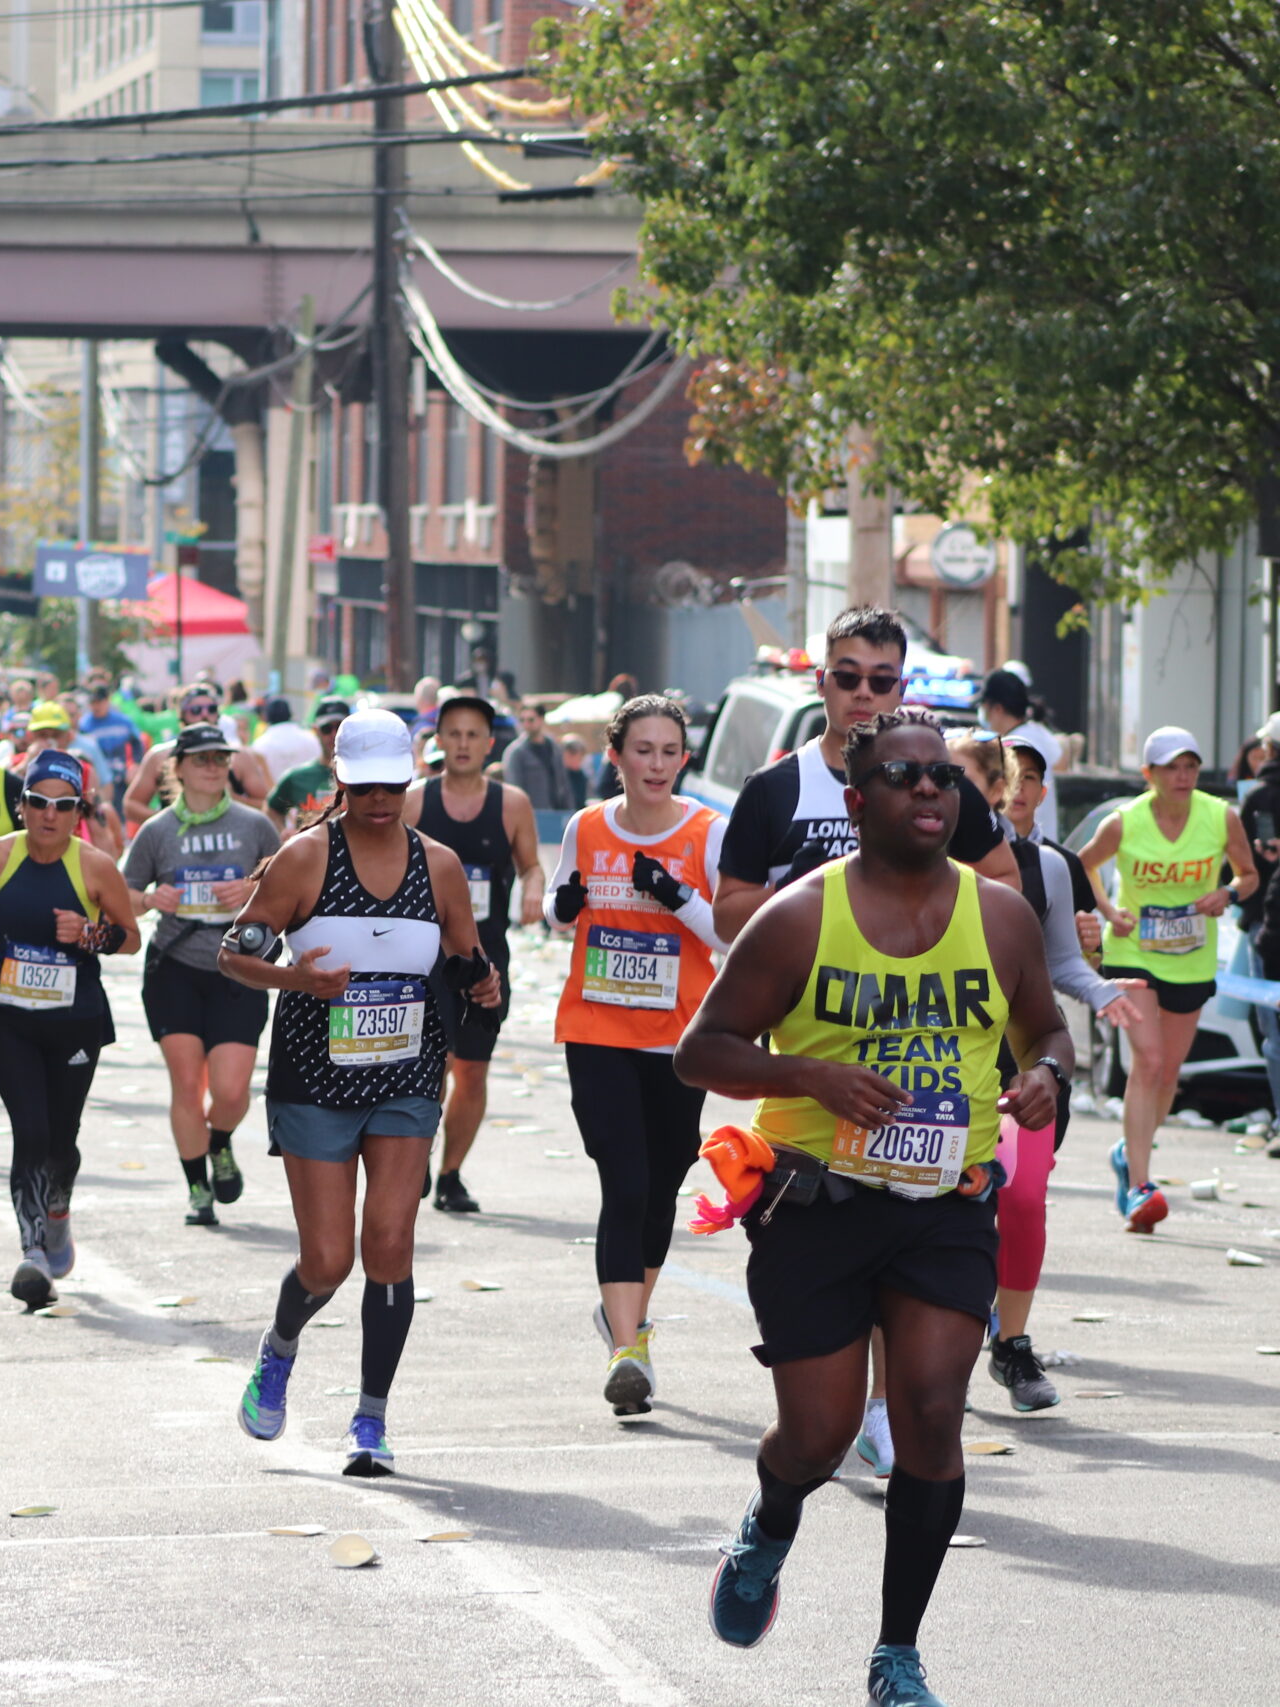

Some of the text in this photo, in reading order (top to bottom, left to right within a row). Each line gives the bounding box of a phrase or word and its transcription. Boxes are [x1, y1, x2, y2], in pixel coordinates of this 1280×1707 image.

[181, 833, 241, 855] JANEL
[588, 885, 634, 898] FRED'S
[1160, 919, 1192, 937] 21530
[21, 965, 60, 988] 13527
[612, 953, 658, 982] 21354
[815, 965, 994, 1030] OMAR
[357, 1006, 407, 1036] 23597
[852, 1034, 961, 1062] TEAM
[935, 1113, 955, 1121] TATA
[867, 1124, 945, 1165] 20630
[949, 1135, 960, 1160] 2021
